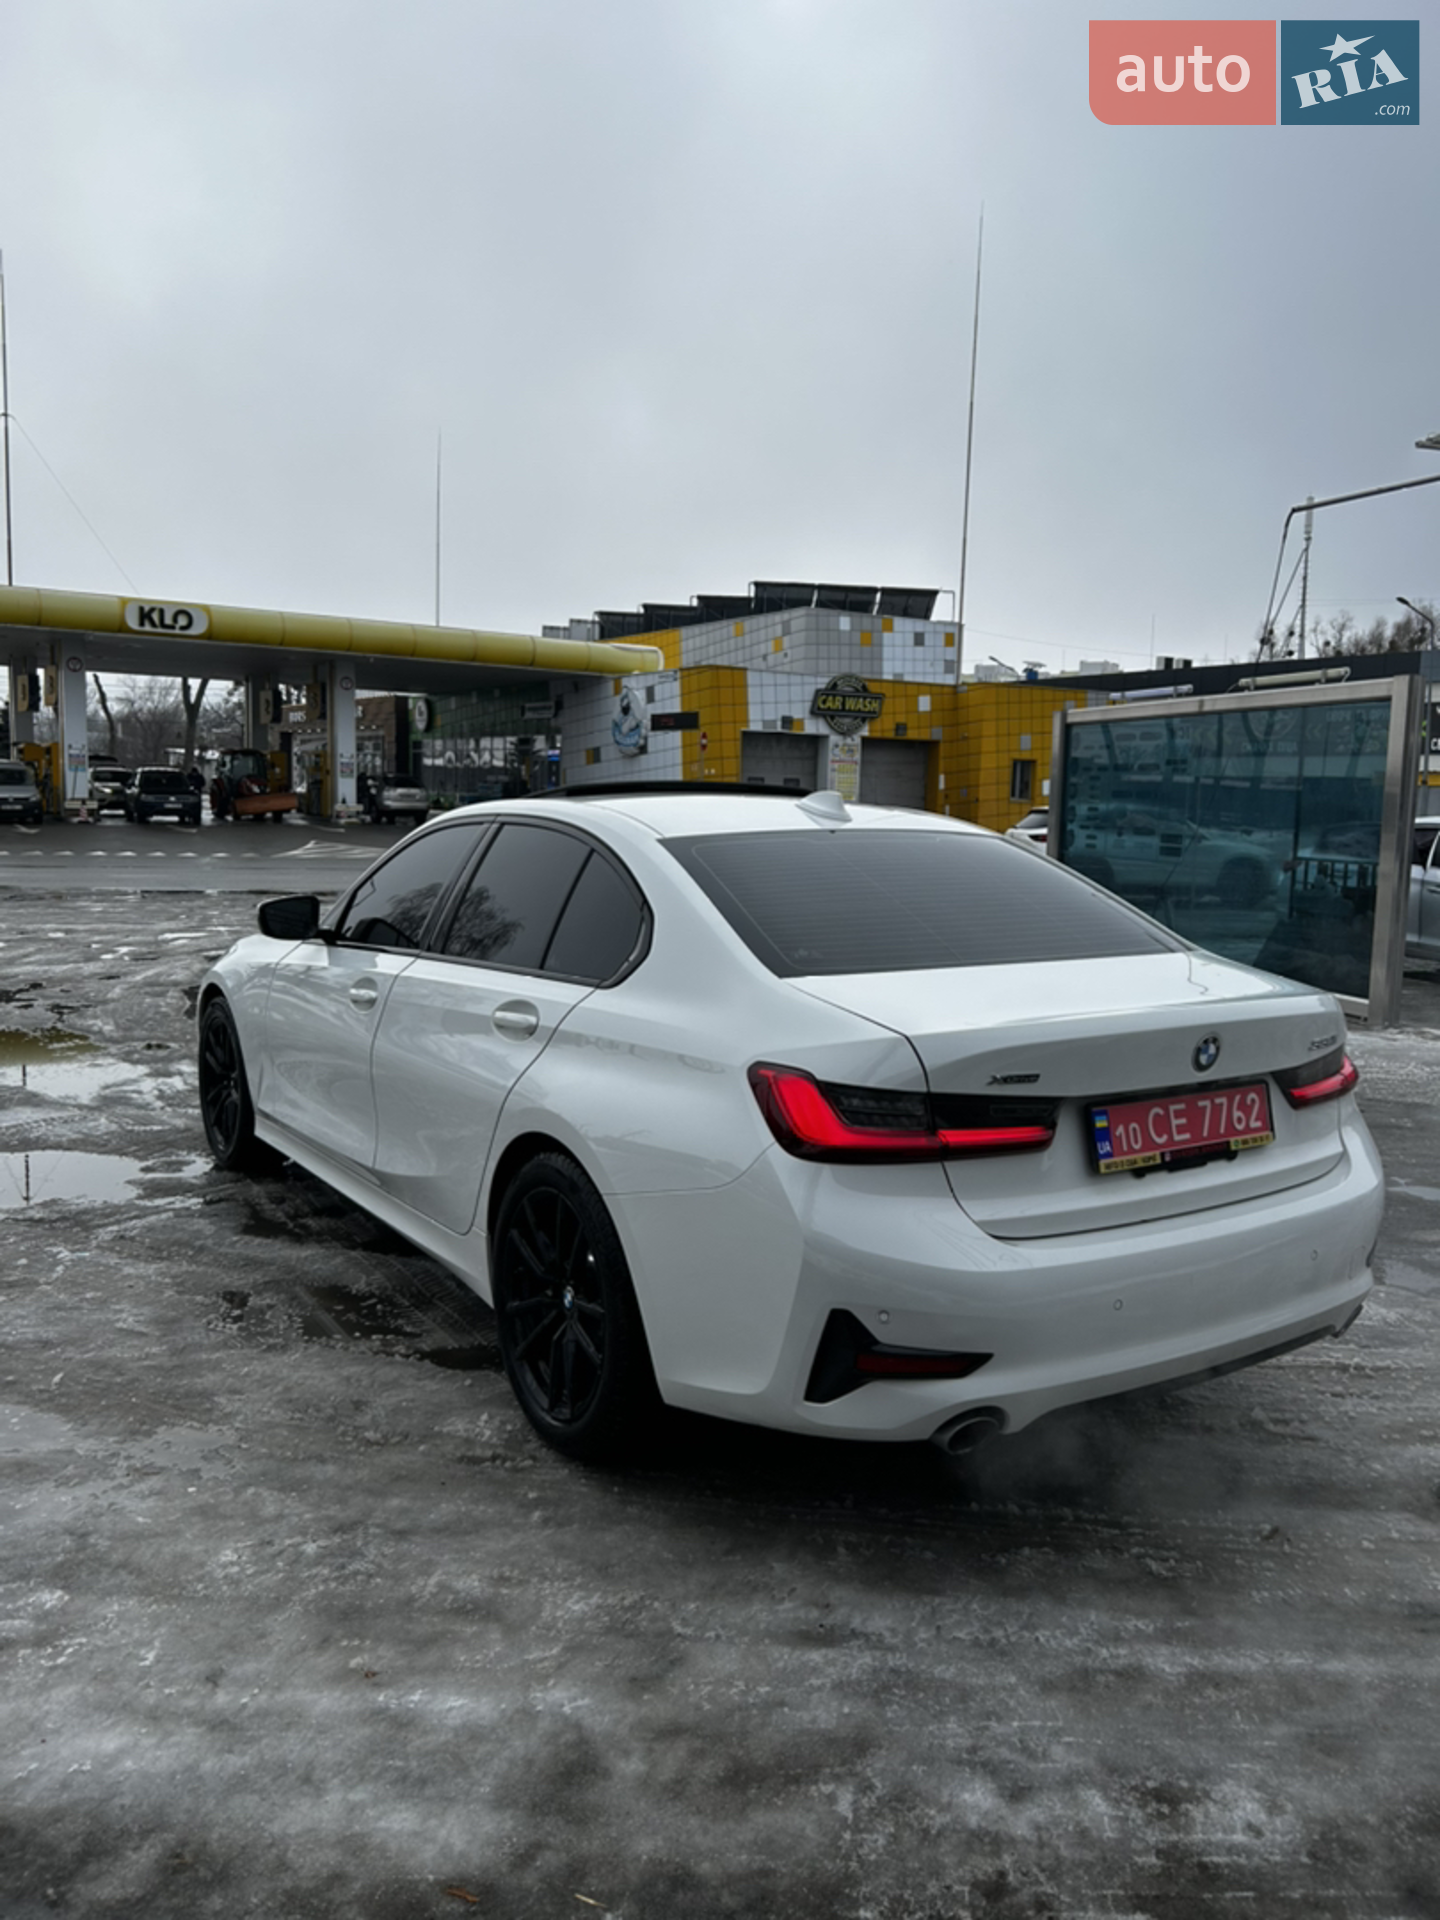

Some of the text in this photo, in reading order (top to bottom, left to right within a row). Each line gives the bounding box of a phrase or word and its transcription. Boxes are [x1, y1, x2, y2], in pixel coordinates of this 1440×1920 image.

[137, 605, 194, 631] KLO
[817, 695, 879, 712] CAR WASH
[1115, 1092, 1262, 1152] 10 CE 7762
[1096, 1140, 1113, 1155] UA
